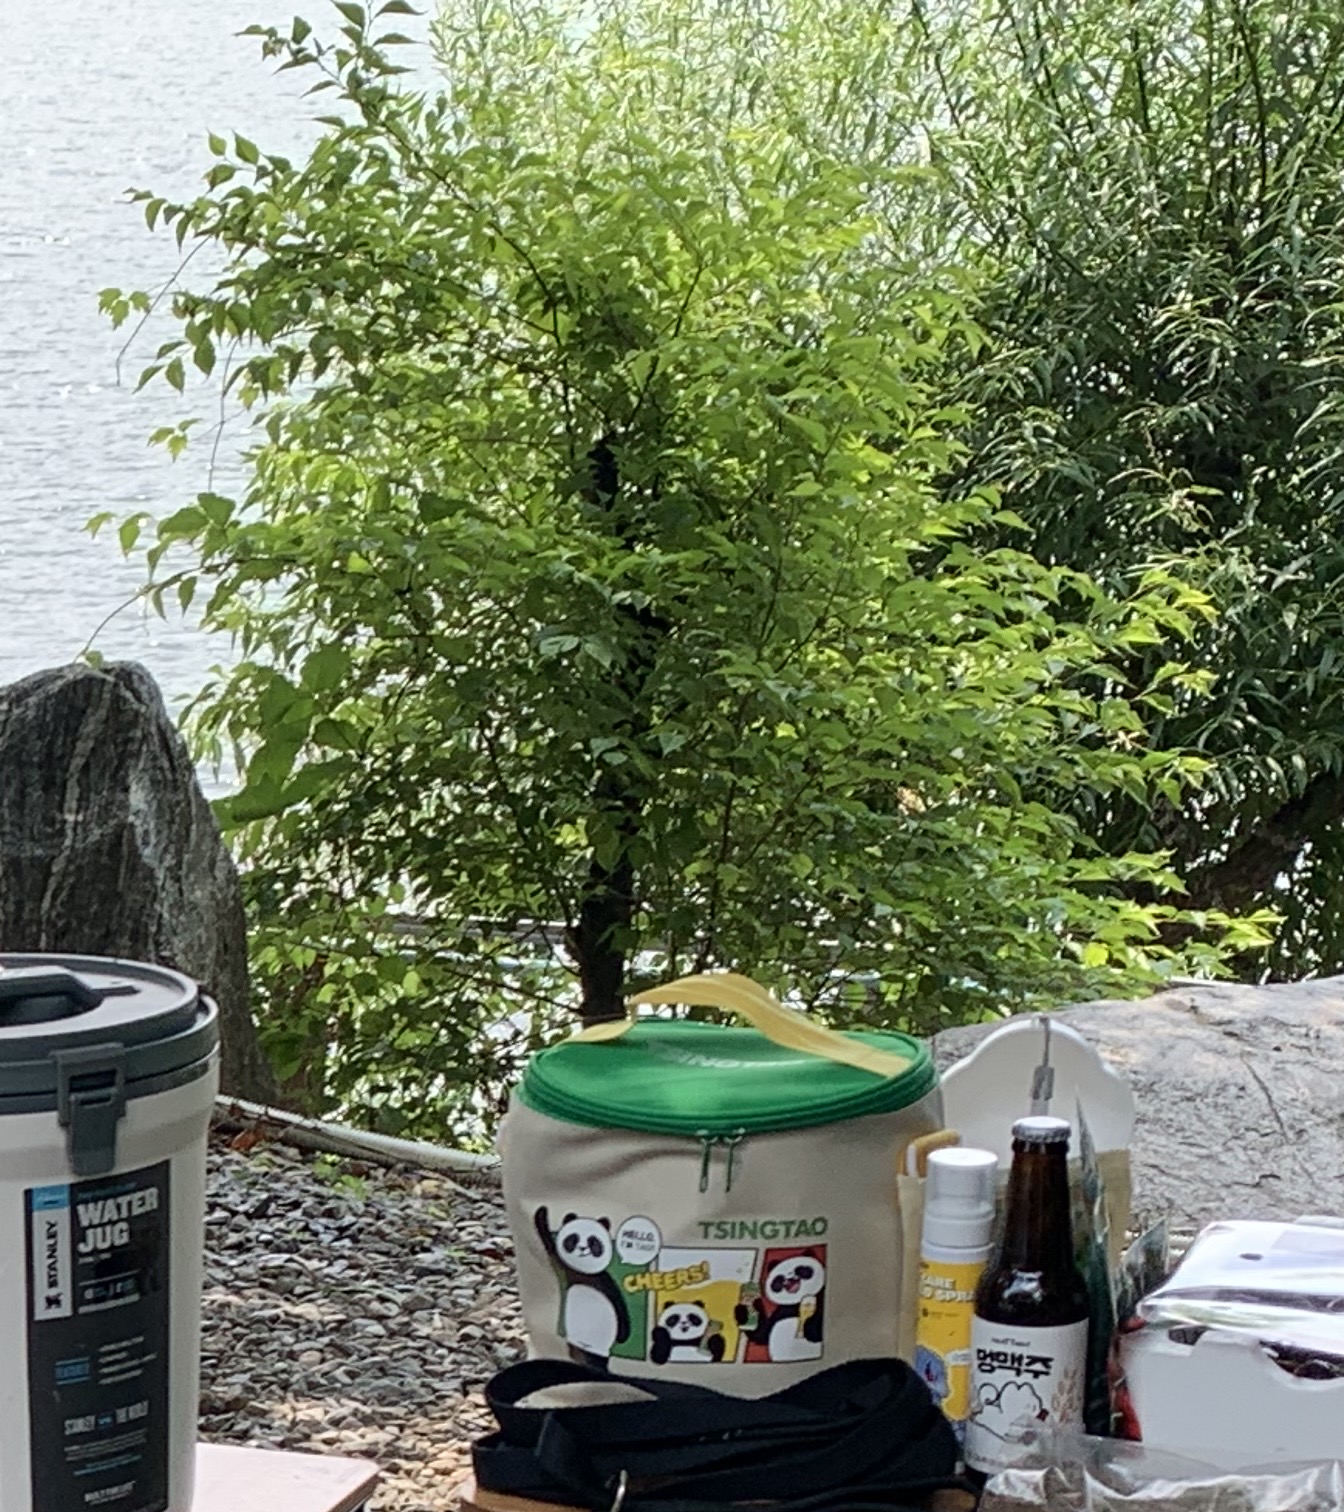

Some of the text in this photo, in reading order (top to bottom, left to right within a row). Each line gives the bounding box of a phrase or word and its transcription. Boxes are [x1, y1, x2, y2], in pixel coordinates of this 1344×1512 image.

[76, 1187, 159, 1228] WATER
[77, 1221, 130, 1254] JUG
[698, 1217, 829, 1240] TSINGTAO
[45, 1220, 59, 1289] STANLEY
[623, 1261, 710, 1293] CHEERS!
[976, 1348, 1055, 1379] 멍맥주
